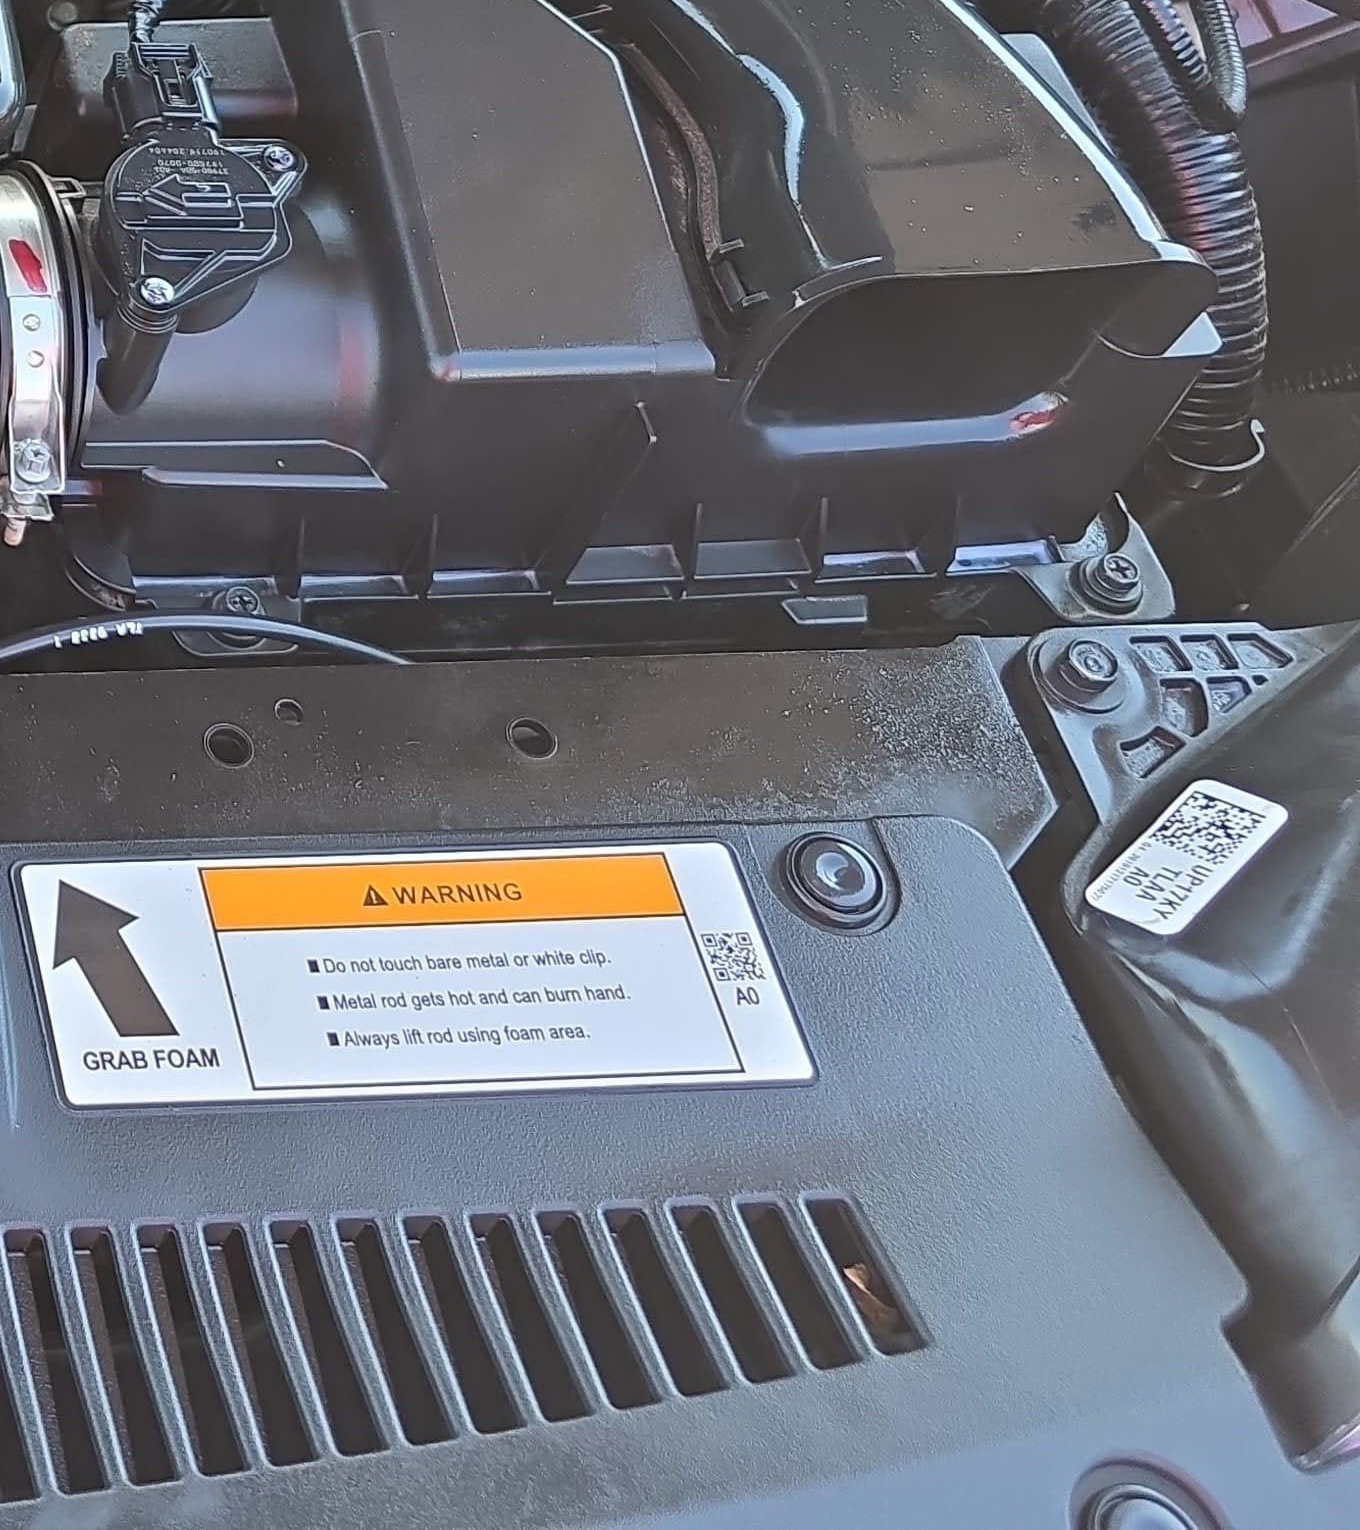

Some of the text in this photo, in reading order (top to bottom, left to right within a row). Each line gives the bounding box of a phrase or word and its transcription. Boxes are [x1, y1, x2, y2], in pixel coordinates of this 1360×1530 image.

[392, 881, 523, 906] WARNING
[1135, 866, 1183, 902] TLAA
[1152, 864, 1214, 920] UP17KY
[323, 949, 612, 973] Do not touch bare metal or white clip.
[332, 984, 631, 1011] Metal rod gets hot and can burn hand.
[735, 986, 761, 1007] A0
[344, 1025, 591, 1049] Always lift rod using foam area.
[83, 1046, 221, 1072] GRAB FOAM
